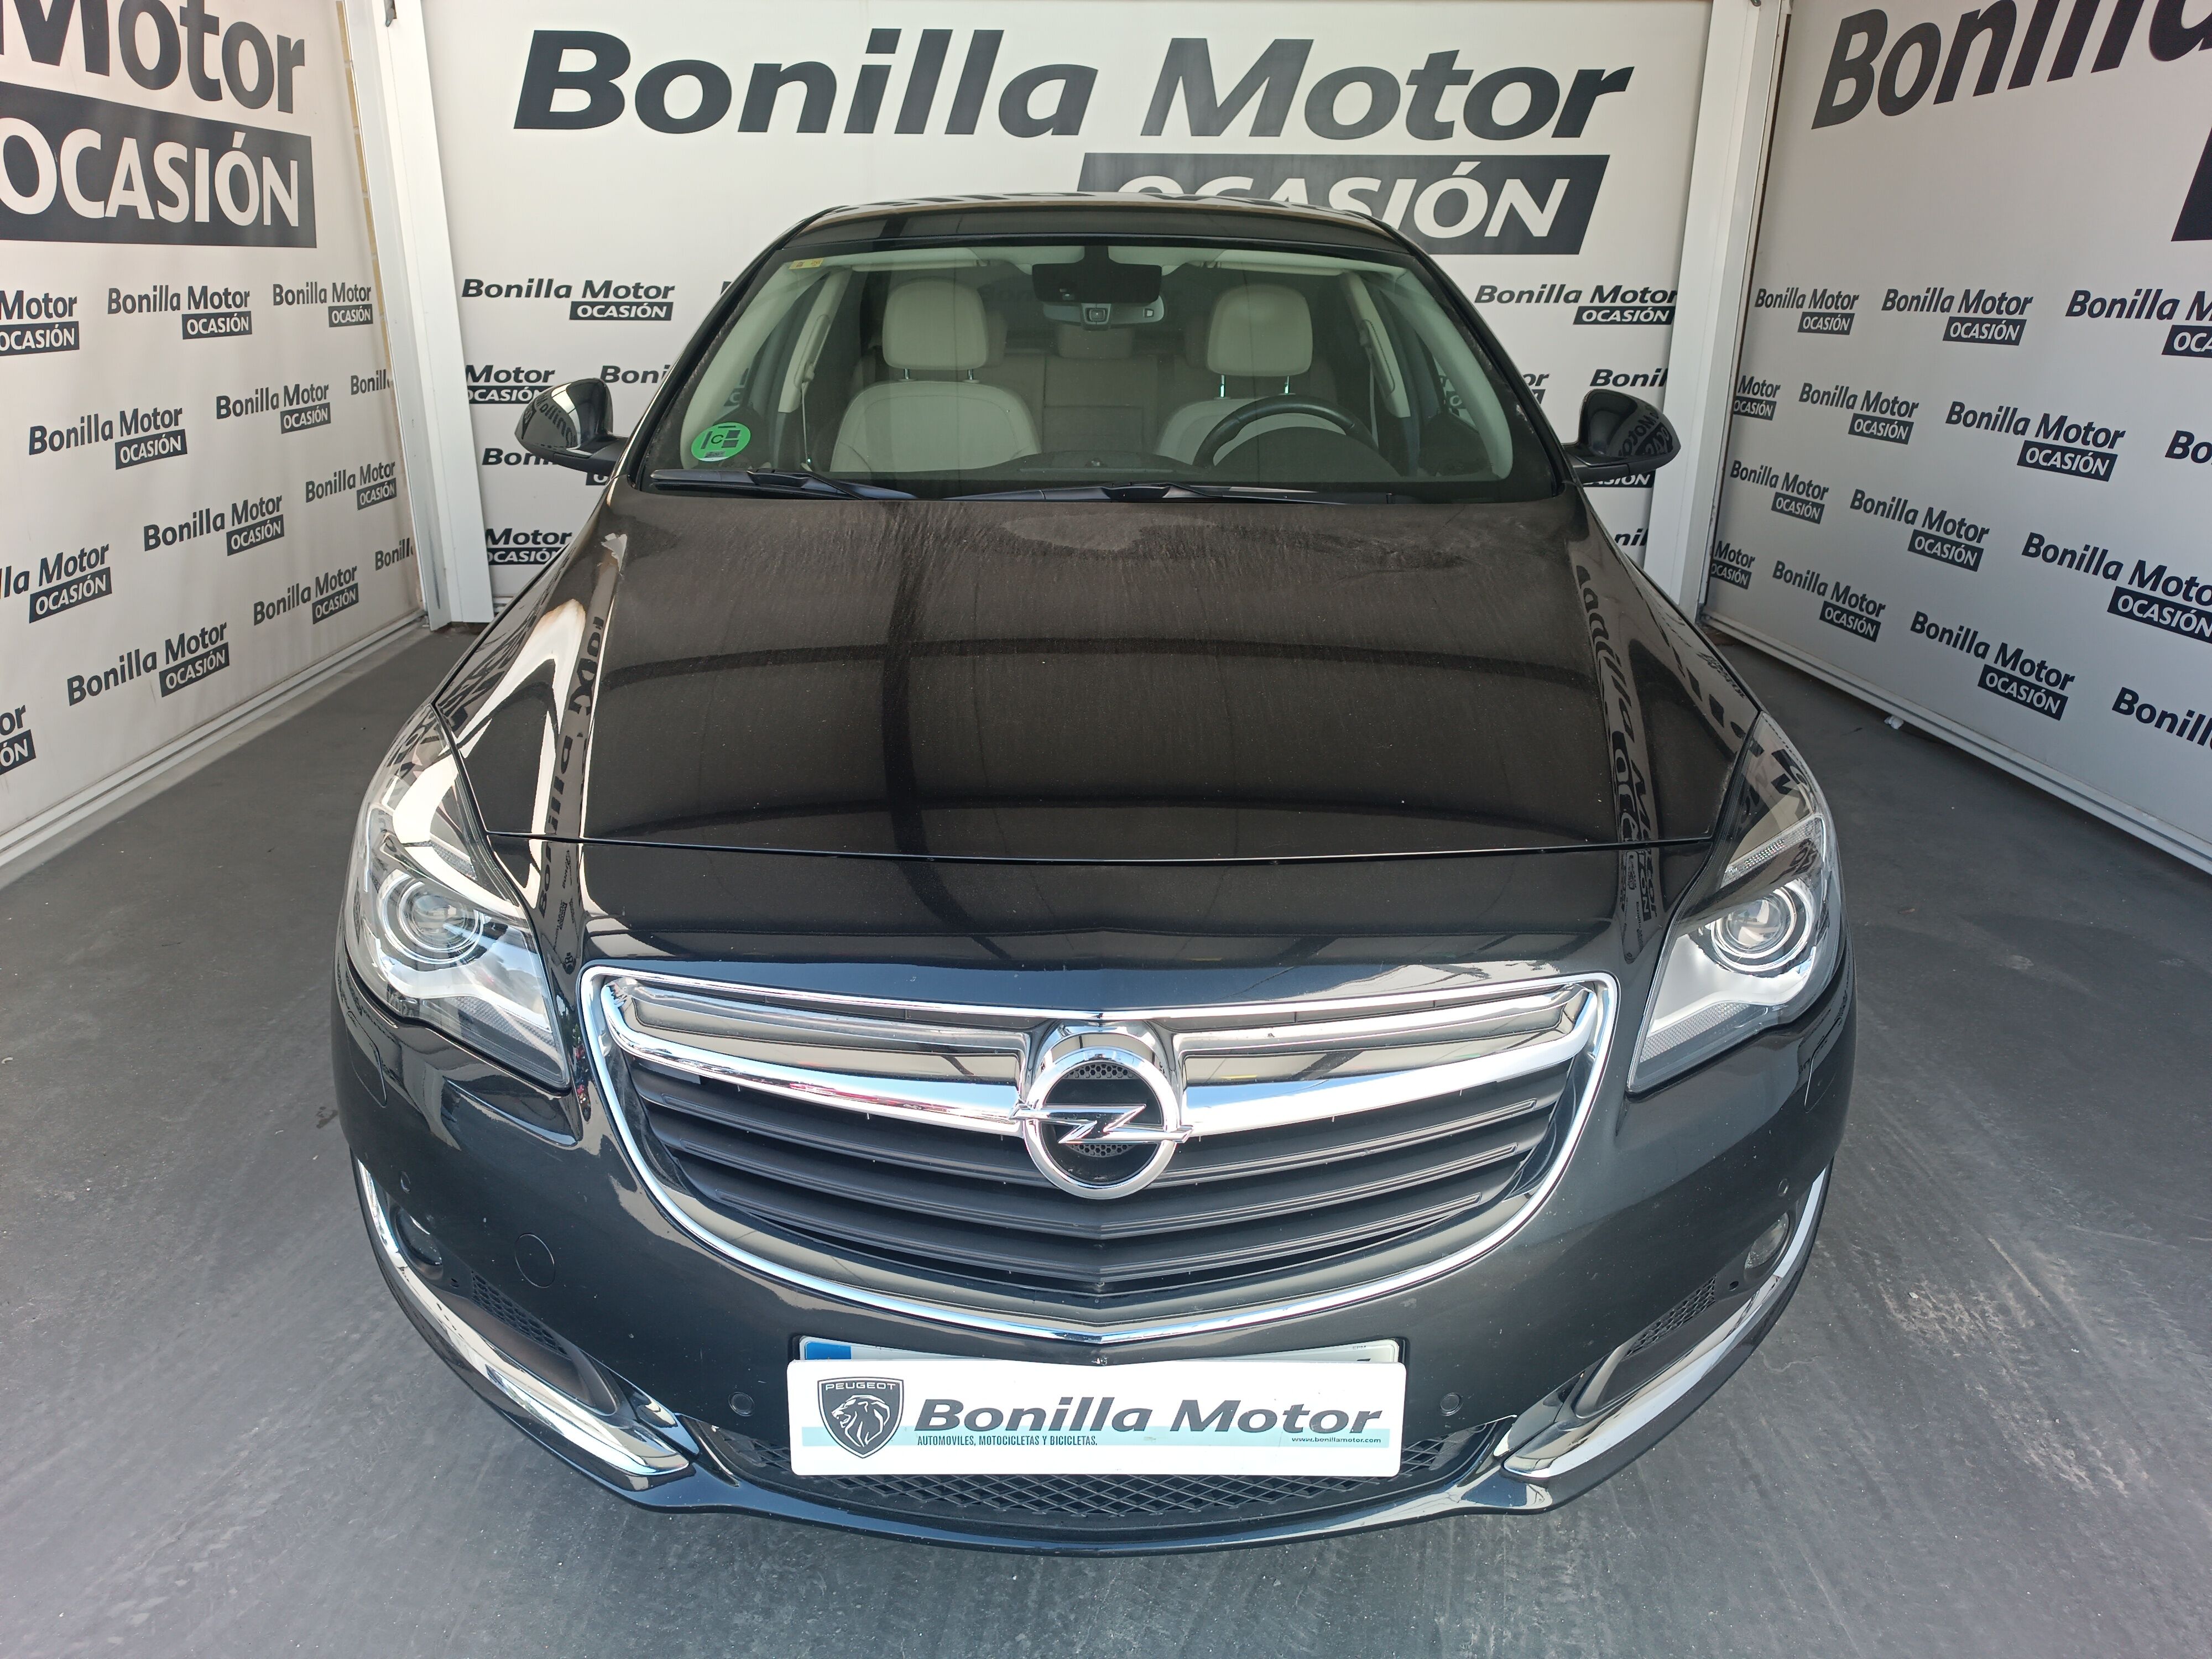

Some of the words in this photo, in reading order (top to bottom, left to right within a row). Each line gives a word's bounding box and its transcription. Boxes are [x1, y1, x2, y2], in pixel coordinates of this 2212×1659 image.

[0, 0, 305, 113] Motor
[514, 28, 1098, 138] Bonilla
[1140, 38, 1635, 140] Motor
[0, 118, 298, 226] OCASIÓN
[108, 285, 180, 314] Bonilla
[188, 286, 249, 310] Motor
[273, 281, 327, 305] Bonilla
[332, 283, 371, 302] Motor
[462, 279, 572, 298] Bonilla
[582, 280, 675, 299] Motor
[1474, 284, 1582, 304] Bonilla
[1590, 285, 1678, 304] Motor
[1754, 288, 1806, 309] Bonilla
[1808, 289, 1859, 310] Motor
[1881, 288, 1954, 312] Bonilla
[1958, 289, 2033, 315] Motor
[0, 290, 77, 320] Motor
[332, 306, 371, 324] OCASIÓN
[577, 303, 666, 317] OCASIÓN
[1582, 307, 1669, 322] OCASIÓN
[2065, 289, 2180, 320] Bonilla
[0, 324, 74, 351] OCASIÓN
[187, 313, 248, 335] OCASIÓN
[1803, 314, 1850, 331] OCASIÓN
[1950, 320, 2020, 340] OCASIÓN
[465, 365, 555, 383] Motor
[1738, 375, 1781, 398] Motor
[216, 387, 279, 419] Bonilla
[284, 384, 328, 407] Motor
[1734, 399, 1773, 416] OCASIÓN
[1799, 383, 1858, 409] Bonilla
[1860, 390, 1919, 418] Motor
[29, 414, 113, 455] Bonilla
[120, 408, 182, 437] Motor
[284, 406, 327, 429] OCASIÓN
[1854, 419, 1908, 439] OCASIÓN
[1945, 401, 2031, 435] Bonilla
[2034, 413, 2126, 449] Motor
[121, 434, 181, 463] OCASIÓN
[2026, 447, 2109, 476] OCASIÓN
[306, 469, 356, 503] Bonilla
[360, 462, 395, 485] Motor
[360, 482, 394, 505] OCASIÓN
[1730, 460, 1779, 488] Bonilla
[1781, 472, 1829, 500] Motor
[144, 508, 225, 551] Bonilla
[232, 495, 282, 526] Motor
[1776, 498, 1820, 519] OCASIÓN
[1850, 489, 1918, 525] Bonilla
[1922, 507, 1990, 543] Motor
[231, 520, 280, 549] OCASIÓN
[486, 528, 572, 545] Motor
[39, 544, 109, 586] Motor
[1715, 541, 1756, 568] Motor
[1915, 536, 1977, 566] OCASIÓN
[2022, 532, 2124, 581] Bonilla
[36, 575, 106, 614] OCASIÓN
[254, 583, 311, 625] Bonilla
[316, 566, 357, 597] Motor
[316, 588, 355, 618] OCASIÓN
[1772, 561, 1828, 596] Bonilla
[1830, 582, 1886, 617] Motor
[1825, 607, 1876, 637] OCASIÓN
[2118, 595, 2212, 637] OCASIÓN
[67, 649, 156, 706] Bonilla
[165, 622, 227, 665] Motor
[1910, 611, 1990, 659] Bonilla
[1994, 643, 2075, 691] Motor
[166, 650, 225, 688] OCASIÓN
[1986, 672, 2060, 713] OCASIÓN
[2112, 687, 2212, 750] Bonill
[825, 1382, 896, 1391] PEUGEOT
[915, 1397, 1154, 1432] Bonilla
[1170, 1400, 1383, 1434] Motor
[917, 1436, 976, 1446] AUTOMOVILES,
[979, 1436, 1039, 1446] MOTOCICLETAS
[1042, 1436, 1047, 1446] Y
[1050, 1436, 1098, 1446] BICICLETAS.
